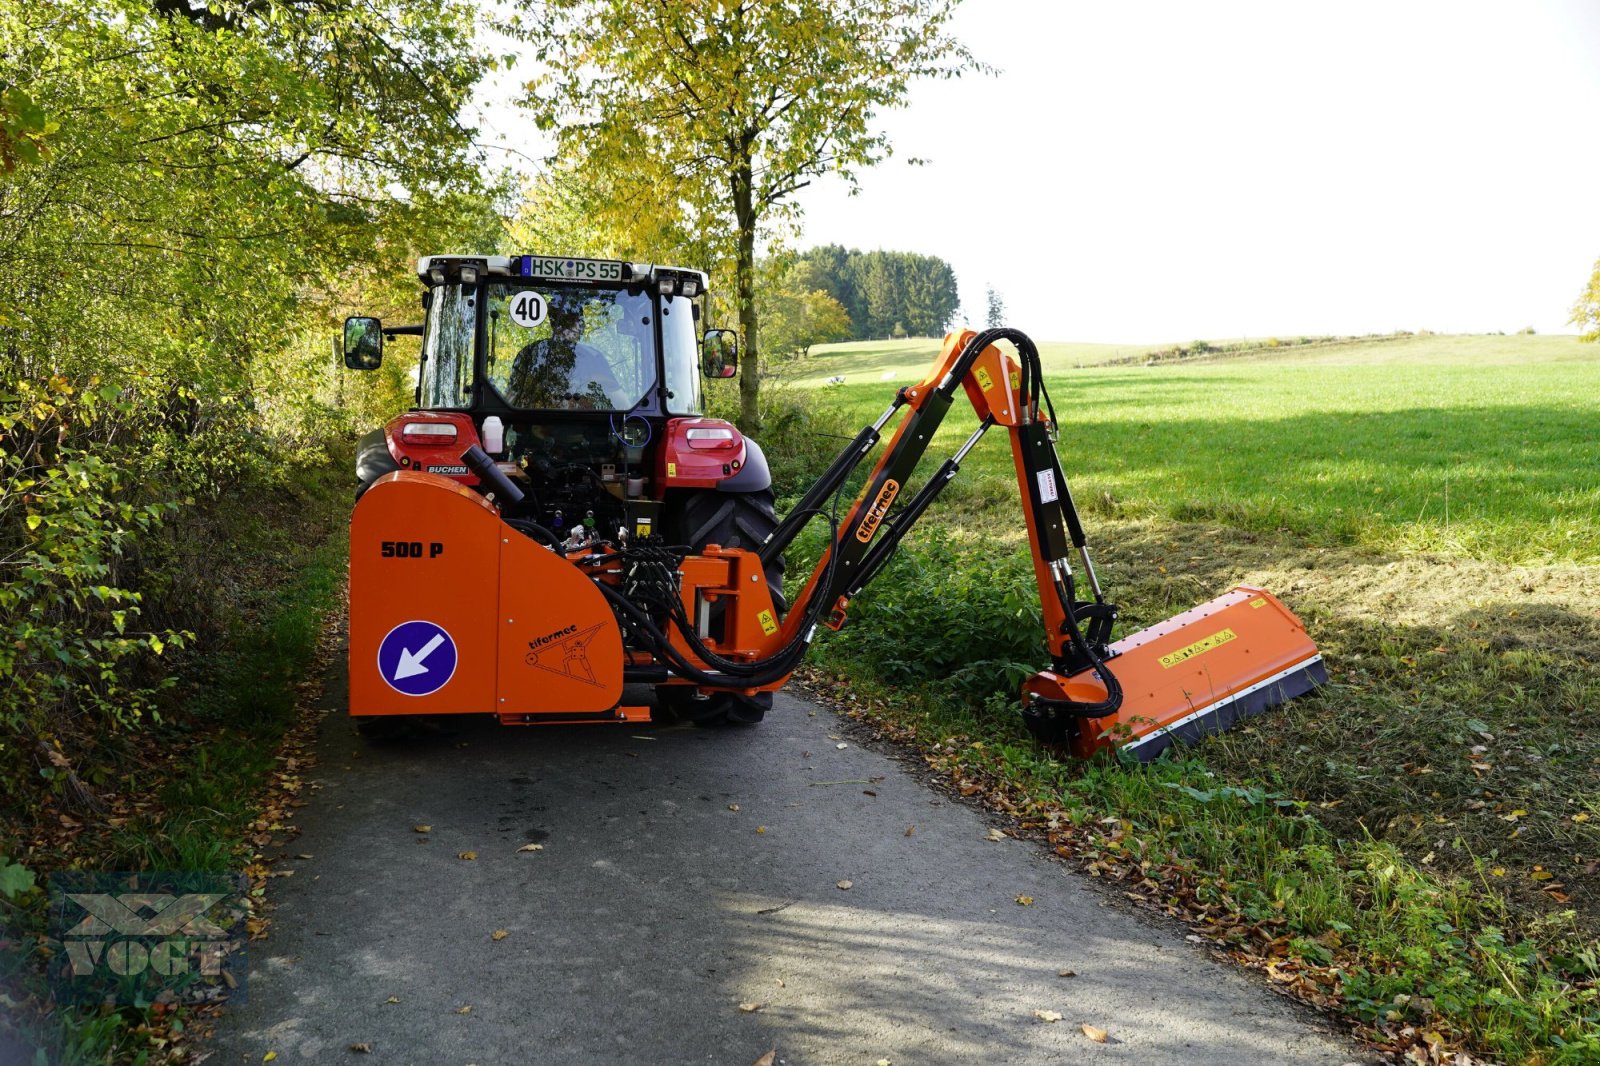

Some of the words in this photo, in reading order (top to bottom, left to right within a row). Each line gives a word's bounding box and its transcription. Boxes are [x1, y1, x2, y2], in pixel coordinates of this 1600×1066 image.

[532, 259, 564, 276] HSK
[576, 262, 596, 278] PS
[600, 263, 620, 279] 55
[515, 297, 540, 321] 40
[858, 482, 896, 538] tifermec
[381, 541, 423, 558] 500
[430, 542, 443, 558] P
[528, 624, 577, 650] tifermec
